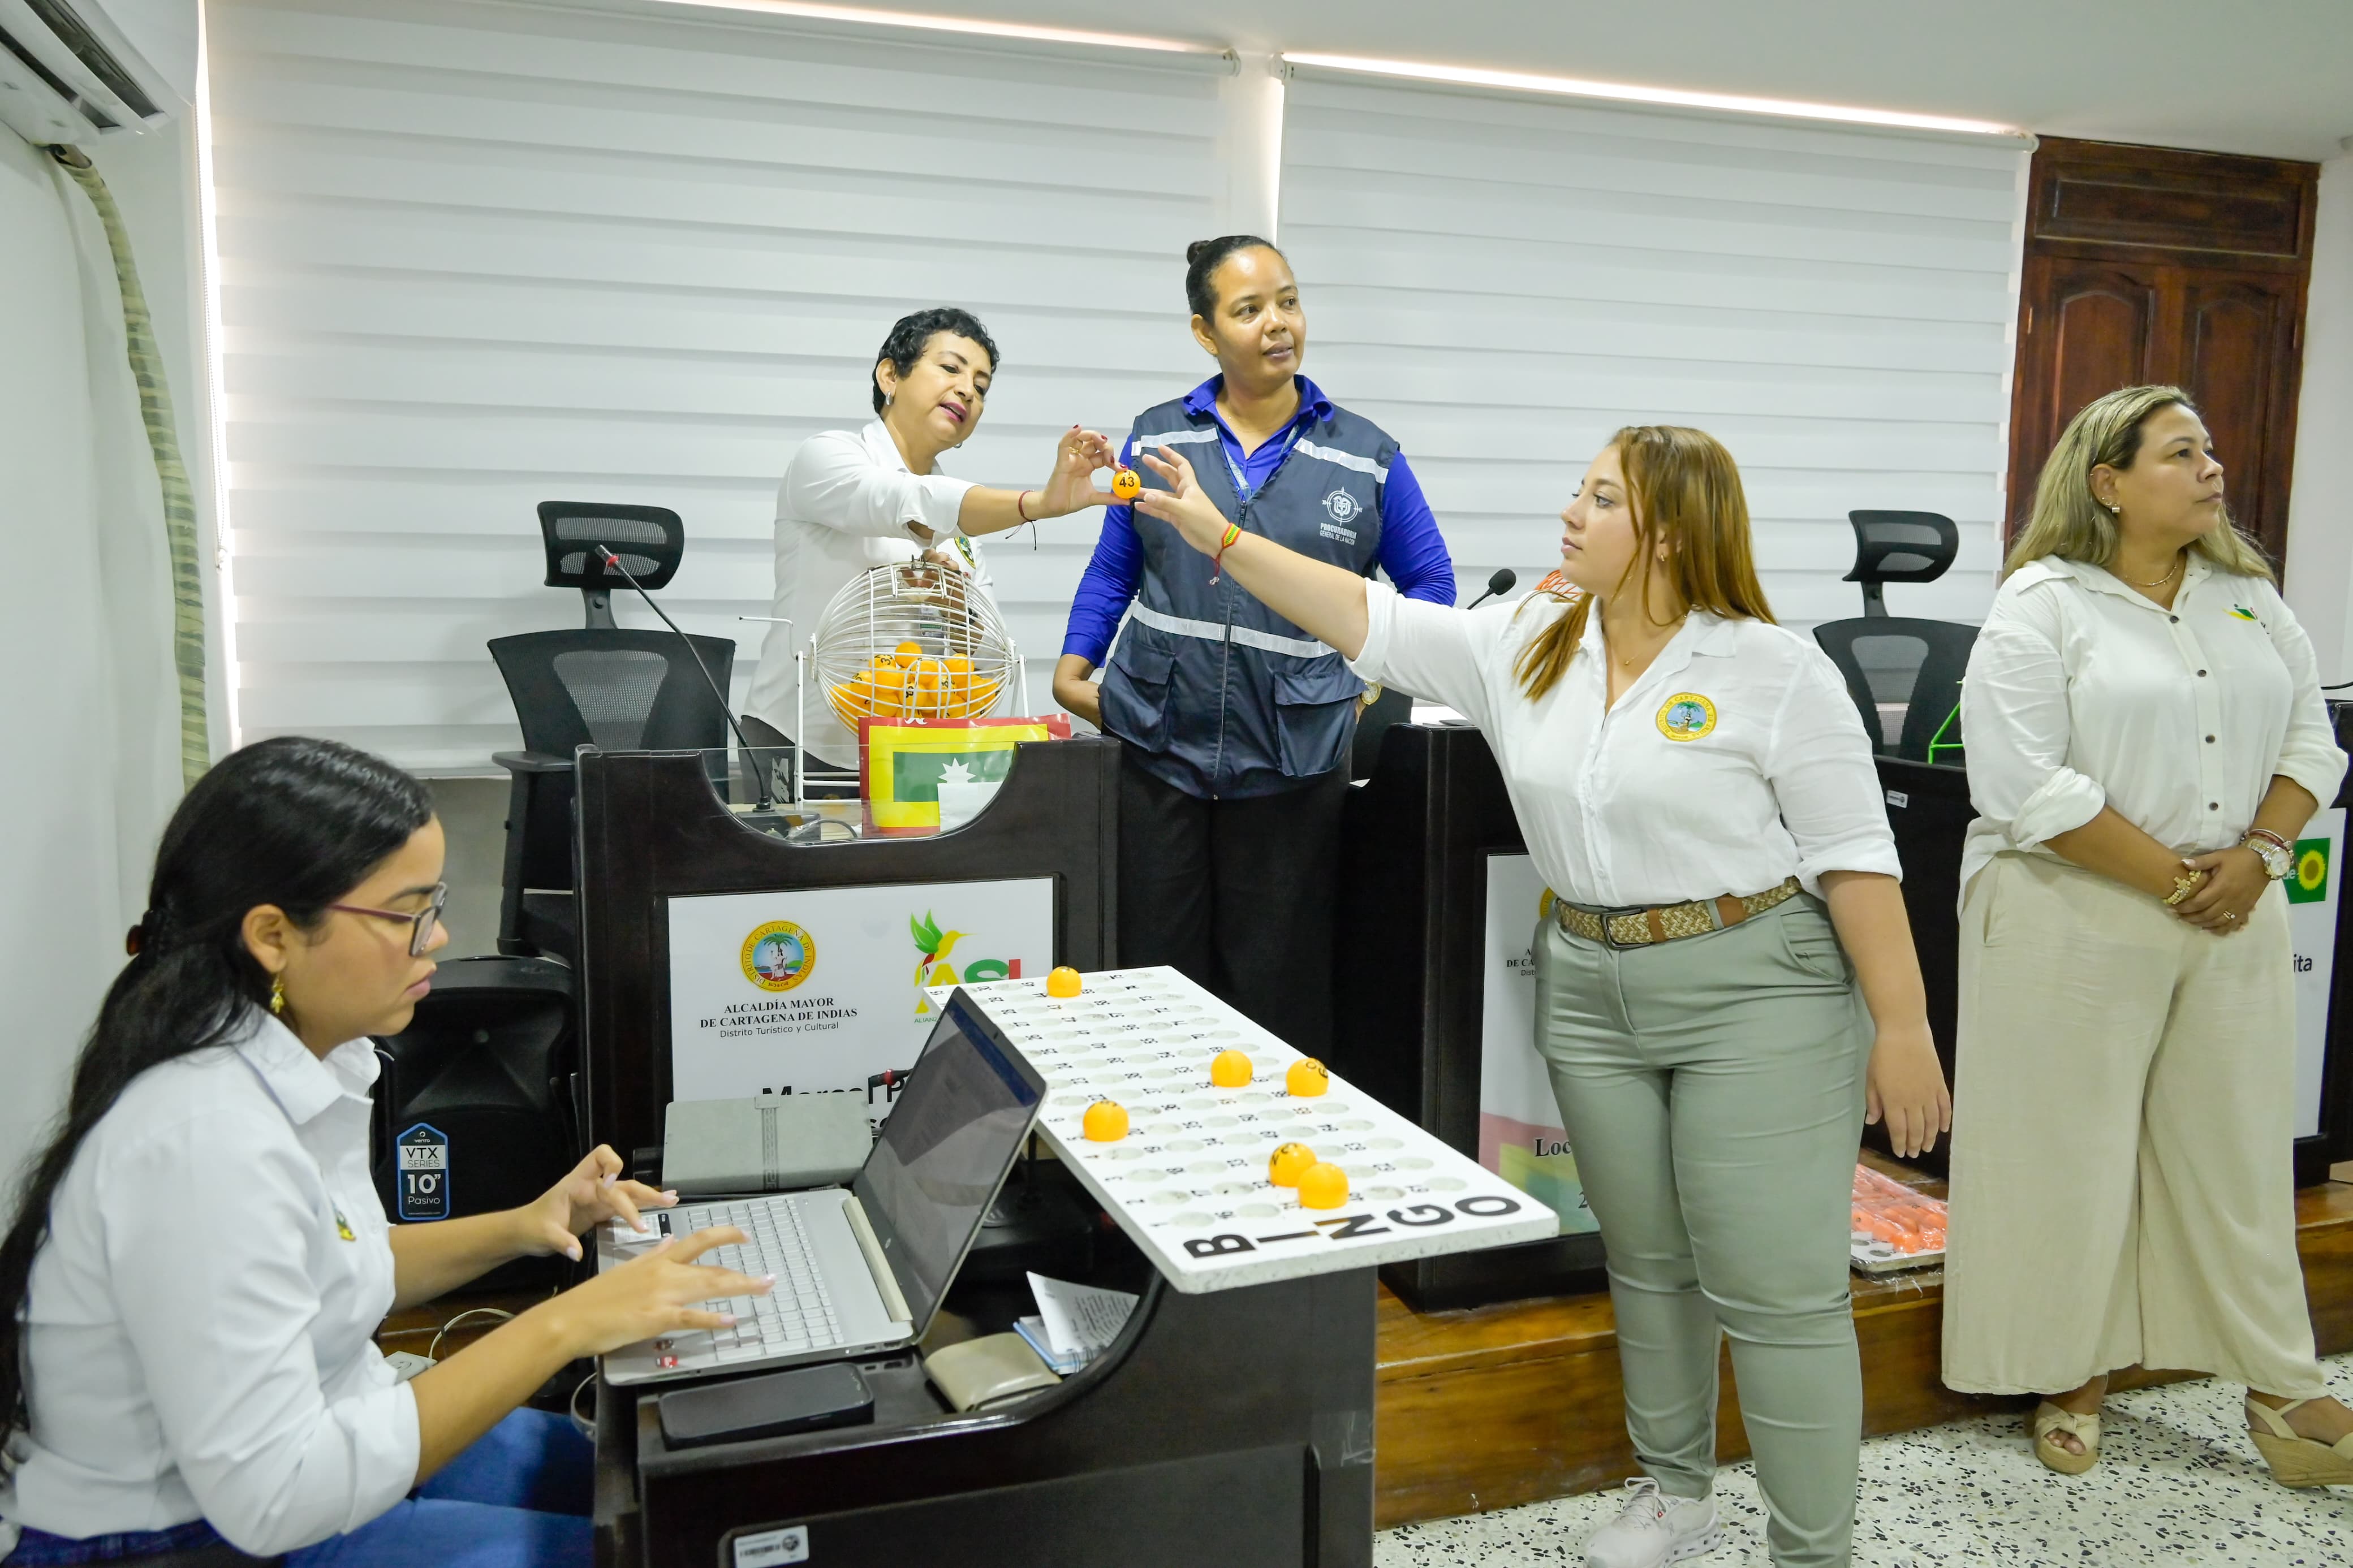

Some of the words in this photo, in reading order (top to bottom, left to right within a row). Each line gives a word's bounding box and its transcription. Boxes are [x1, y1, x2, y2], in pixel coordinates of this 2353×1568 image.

[1119, 476, 1135, 487] 43
[754, 925, 804, 941] CARTAGENA
[746, 942, 756, 952] DE
[802, 942, 811, 951] DE
[745, 954, 765, 985] DISTRITO
[792, 955, 811, 983] INDIAS
[724, 999, 787, 1014] ALCALDÍA
[790, 997, 834, 1009] MAYOR
[700, 1018, 717, 1028] DE
[720, 1013, 795, 1027] CARTAGENA
[798, 1012, 814, 1021] DE
[817, 1008, 857, 1019] INDIAS
[720, 1029, 753, 1038] Distrito
[756, 1026, 793, 1035] Turístico
[804, 1022, 838, 1031] Cultural
[406, 1147, 438, 1159] VTX
[407, 1159, 440, 1168] SERIES
[408, 1196, 441, 1205] Pasivo
[1183, 1196, 1522, 1259] BINGO
